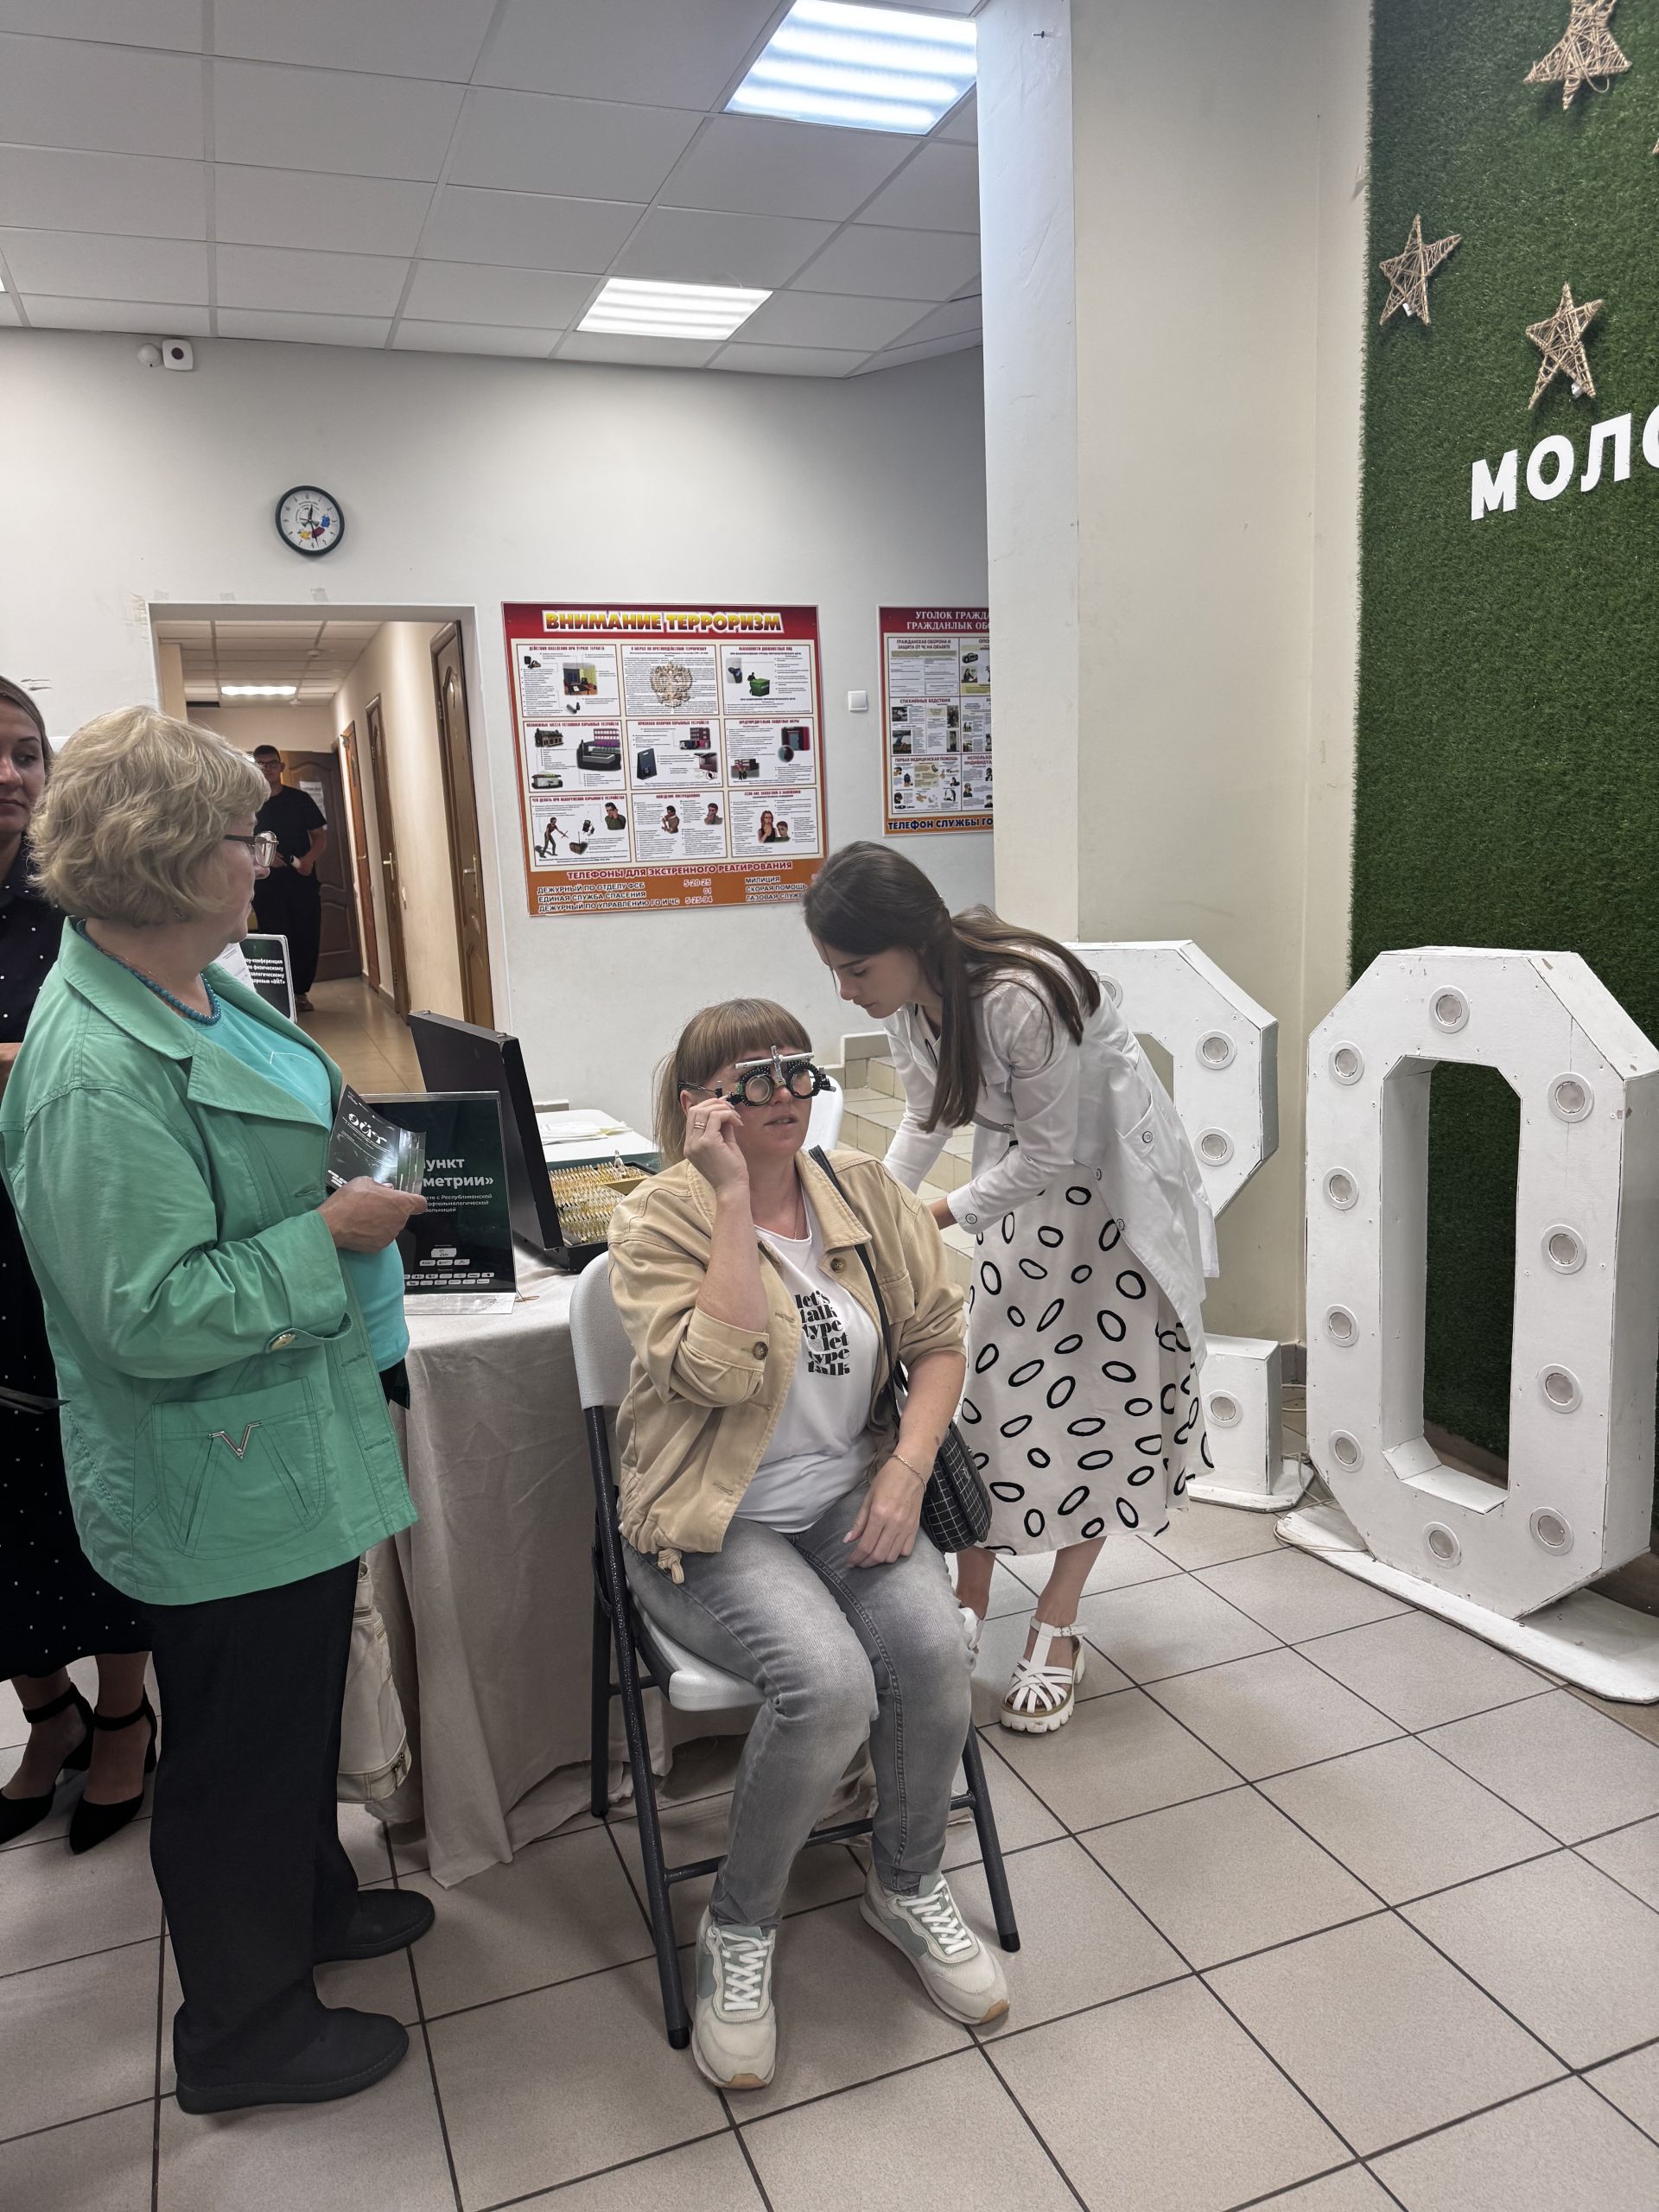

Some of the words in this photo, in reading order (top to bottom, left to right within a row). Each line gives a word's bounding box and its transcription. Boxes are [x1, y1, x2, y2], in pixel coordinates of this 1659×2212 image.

[544, 612, 663, 632] ВНИМАНИЕ
[665, 612, 782, 632] ТЕРРОРИЗМ
[915, 611, 952, 620] УГОЛОК
[906, 621, 973, 631] ГРАЖДАНЛЫК
[888, 820, 933, 830] ТЕЛЕФОН
[936, 818, 980, 828] СЛУЖБЫ
[567, 869, 624, 880] ТЕЛЕФОНЫ
[626, 868, 646, 879] ДЛЯ
[648, 865, 715, 876] ЭКСТРЕННОГО
[718, 861, 792, 873] РЕАГИРОВАНИЯ
[537, 885, 582, 894] ДЕЖУРНЫЙ
[775, 883, 807, 892] ПОМОЩЬ
[539, 903, 583, 912] ДЕЖУРНЫЙ
[598, 900, 649, 909] УПРАВЛЕНИЮ
[423, 1159, 465, 1172] ункт
[423, 1176, 494, 1190] метрии»
[795, 1290, 830, 1309] let's
[800, 1305, 837, 1324] talk
[802, 1319, 843, 1339] type
